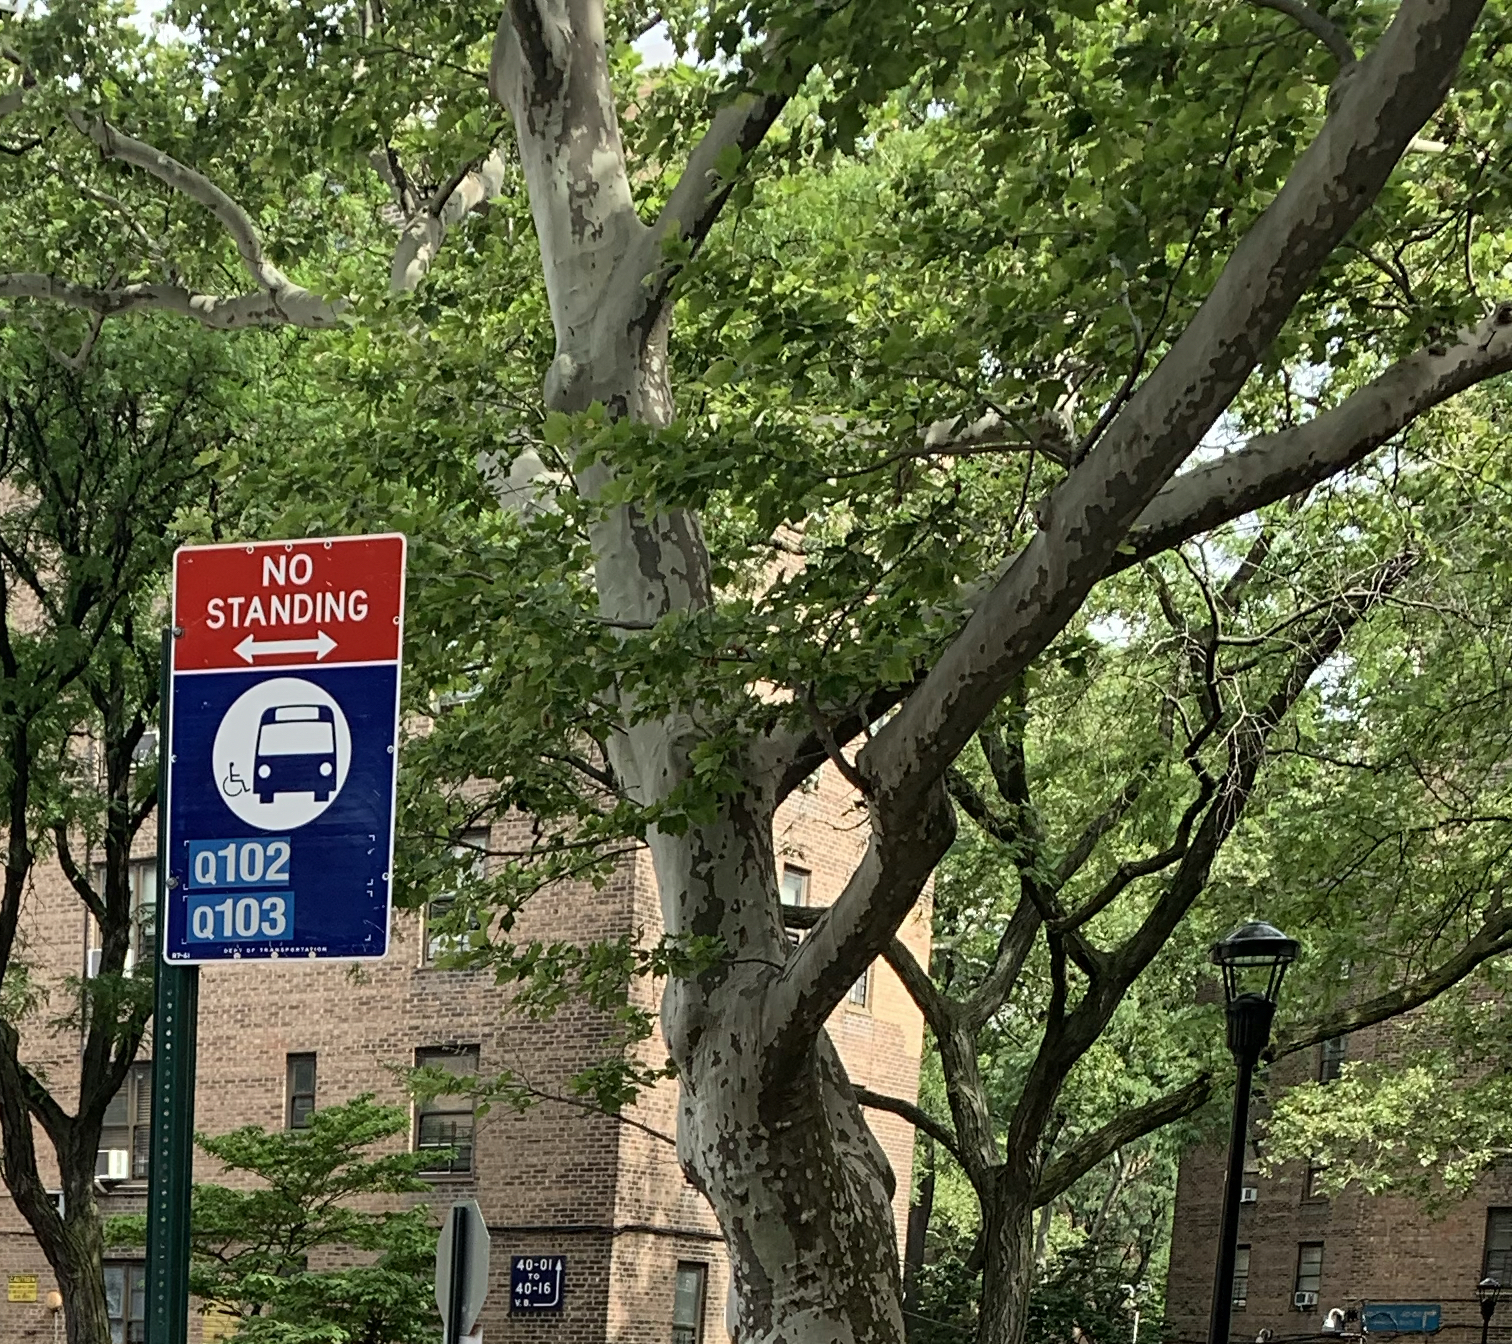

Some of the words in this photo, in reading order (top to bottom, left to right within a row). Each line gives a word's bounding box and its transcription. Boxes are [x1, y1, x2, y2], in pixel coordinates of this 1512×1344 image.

[262, 553, 313, 587] NO
[205, 589, 369, 630] STANDING
[194, 841, 291, 886] Q102
[192, 896, 287, 942] Q103
[516, 1258, 553, 1271] 40-01
[515, 1282, 551, 1294] 40-16
